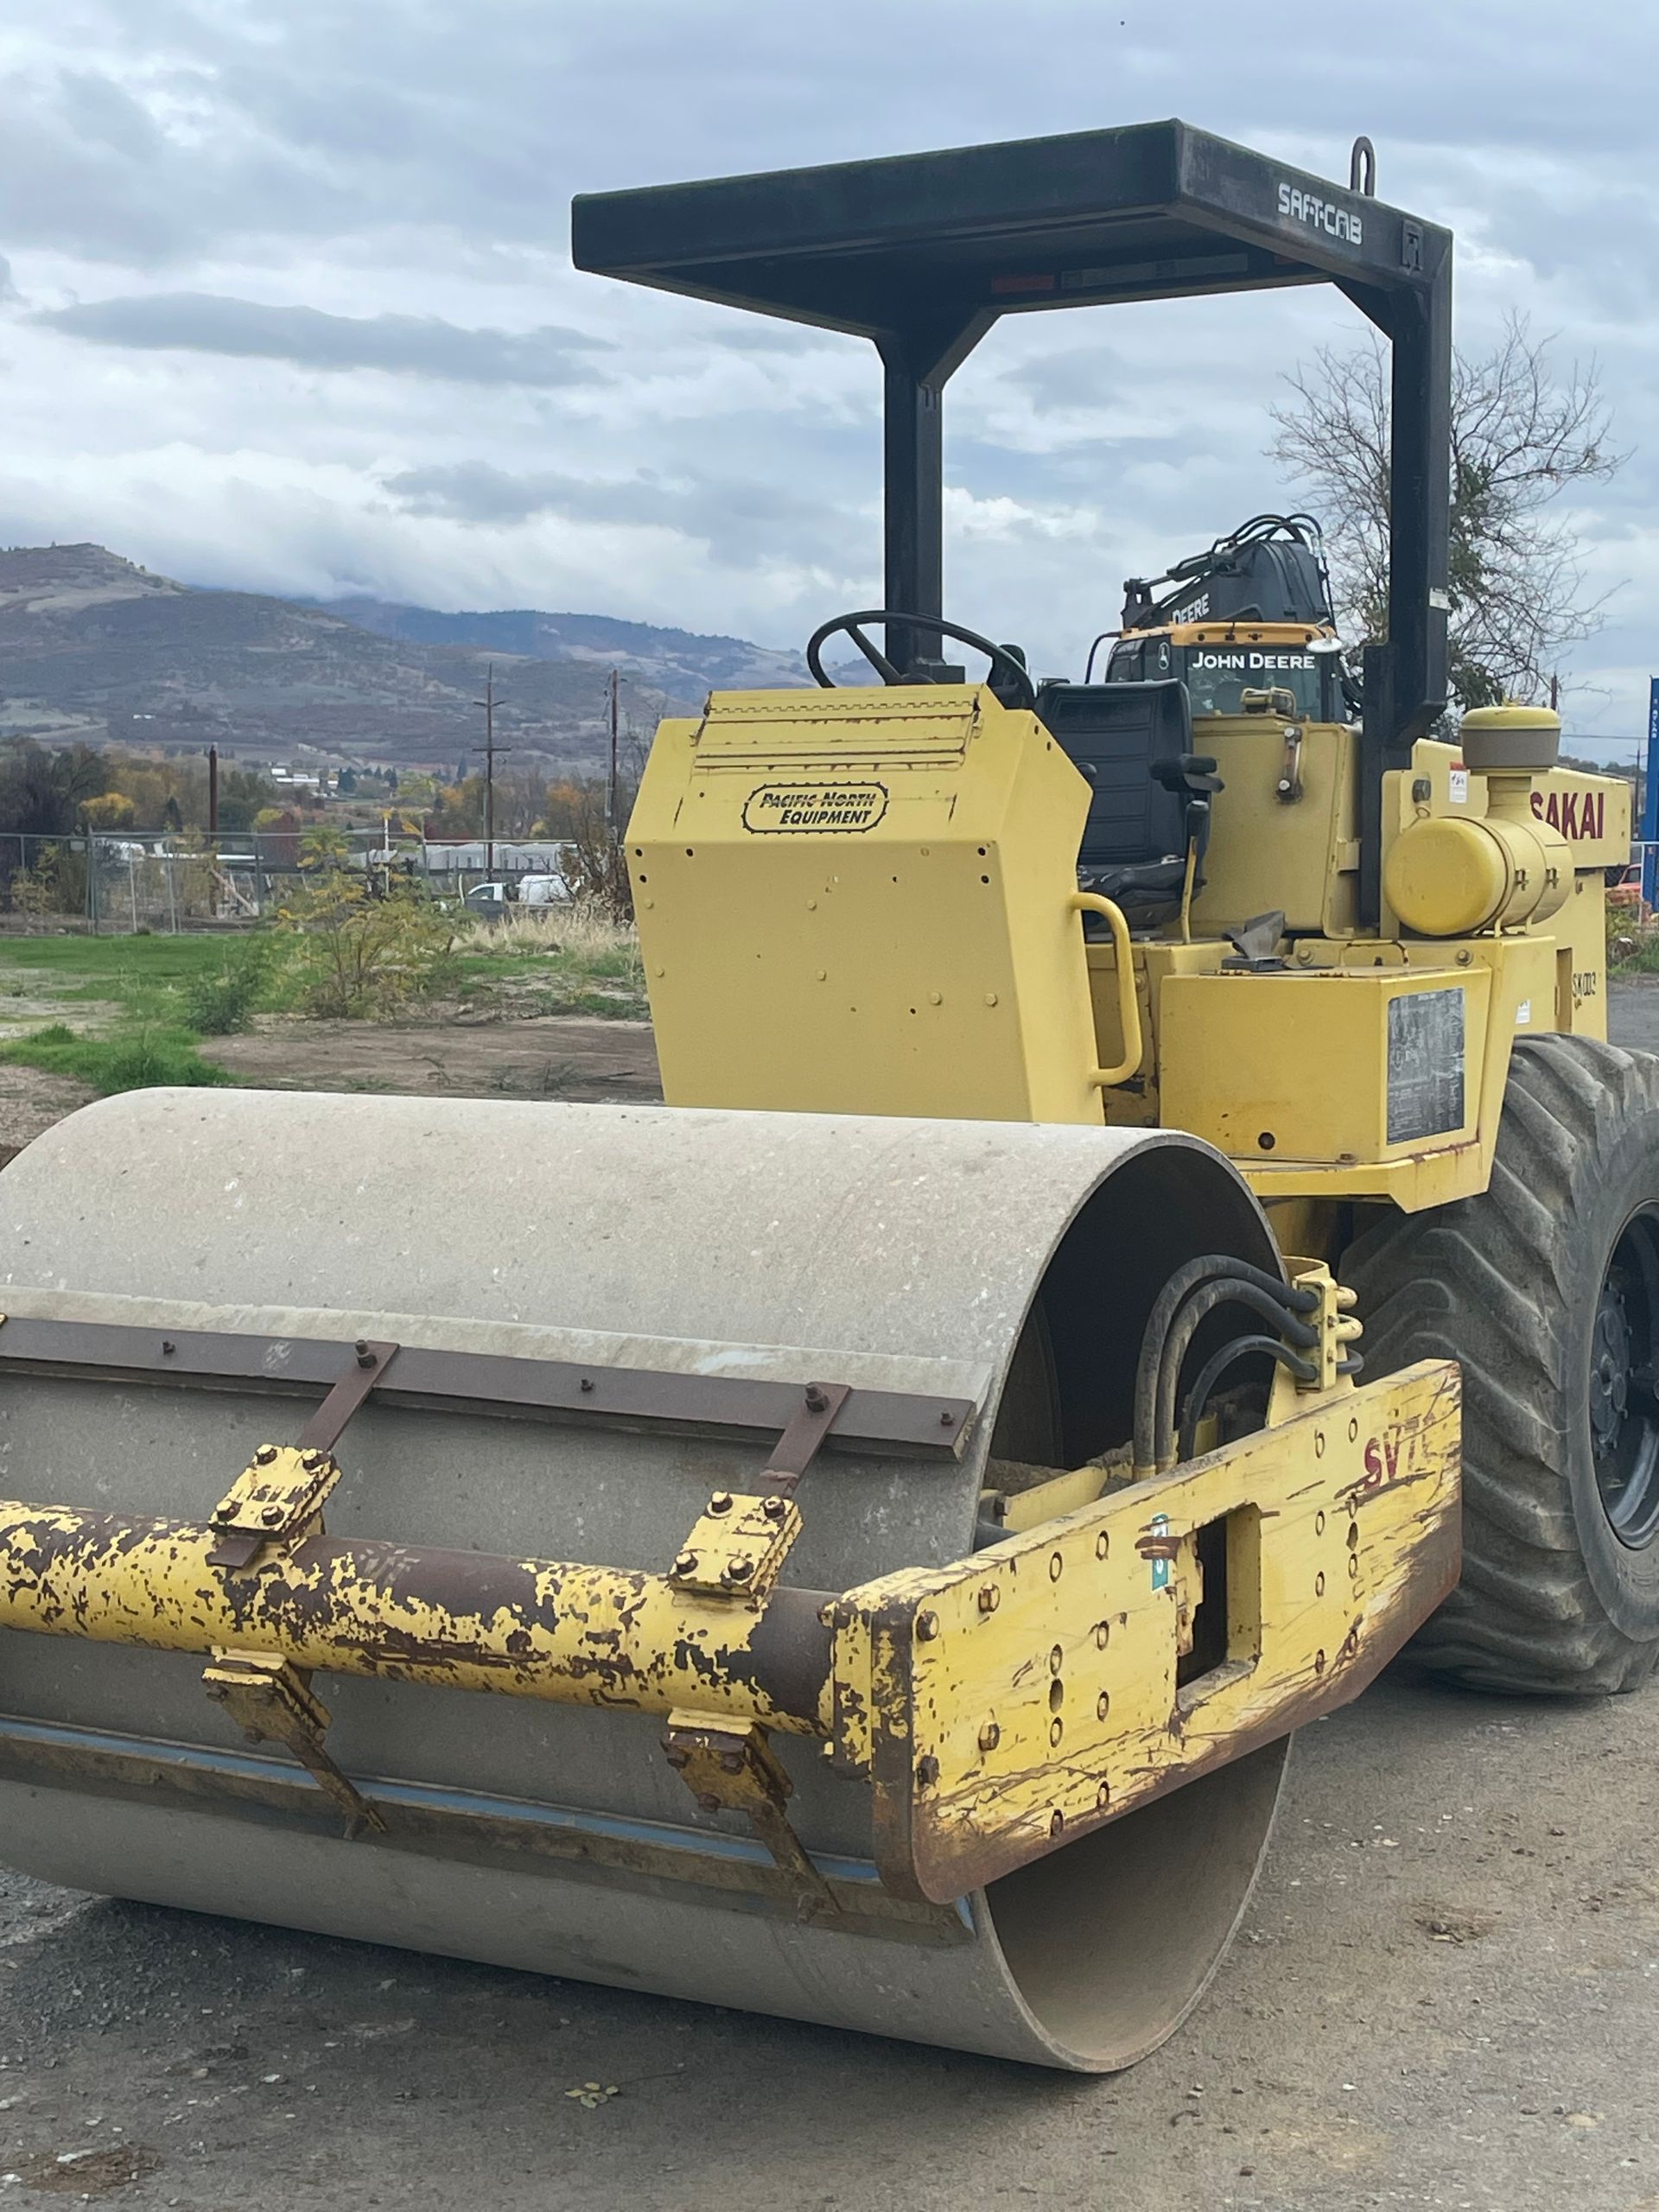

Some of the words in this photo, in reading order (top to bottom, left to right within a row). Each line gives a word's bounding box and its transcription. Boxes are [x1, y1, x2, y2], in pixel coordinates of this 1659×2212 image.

[1192, 652, 1245, 669] JOHN
[1249, 652, 1315, 669] DEERE
[759, 792, 817, 809] PACIFIC
[819, 791, 877, 807] NORTH
[779, 810, 872, 825] EQUIPMENT
[1529, 791, 1605, 841] SAKAI
